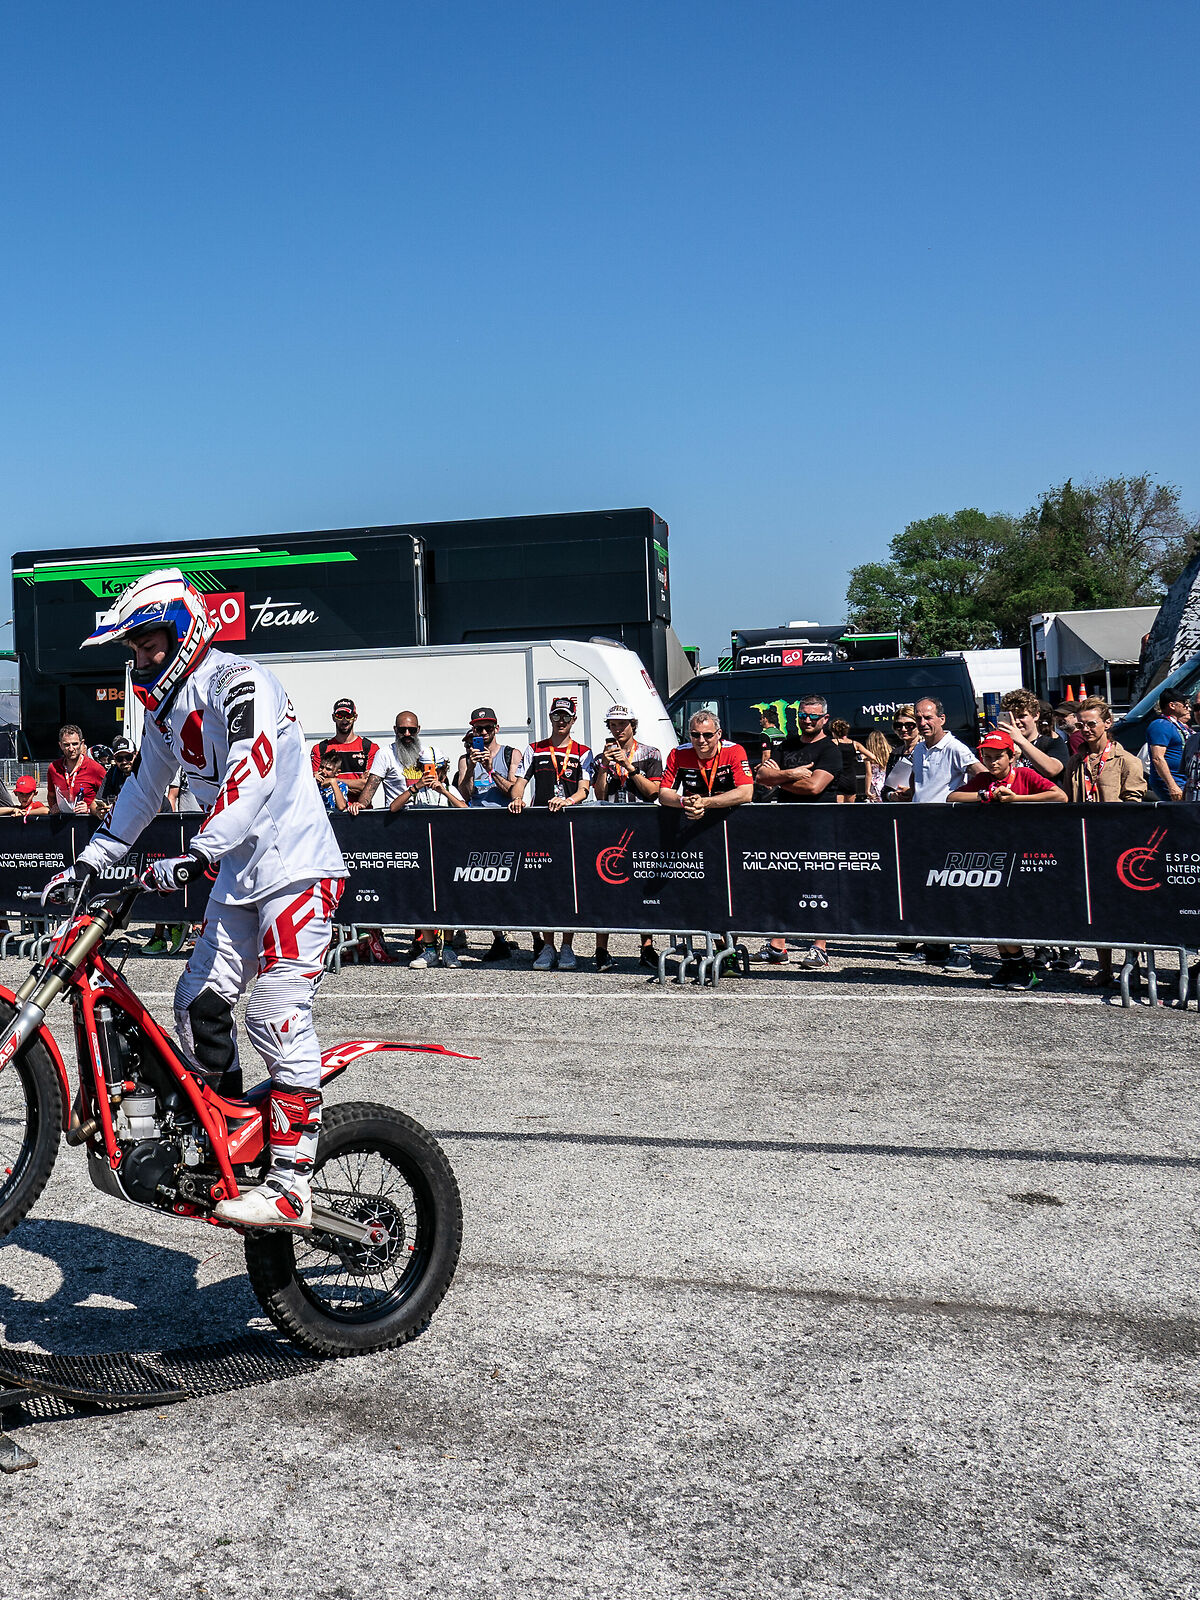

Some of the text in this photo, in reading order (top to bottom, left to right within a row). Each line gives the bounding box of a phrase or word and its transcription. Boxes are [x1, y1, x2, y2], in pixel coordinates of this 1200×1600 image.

[395, 852, 419, 860] 2019
[467, 851, 515, 868] RIDE
[632, 851, 704, 860] ESPOSIZIONE
[742, 851, 880, 860] 7-10 NOVEMBRE 2019
[360, 861, 384, 869] RHO
[386, 861, 420, 869] FIERA
[632, 861, 704, 870] INTERNAZIONALE
[944, 852, 1007, 870] RIDE
[742, 861, 881, 872] MILANO, RHO FIERA
[453, 867, 511, 882] MOOD
[633, 871, 705, 879] CICLO MOTOCICLO
[926, 869, 1002, 887] MOOD
[1167, 876, 1196, 885] CICLO
